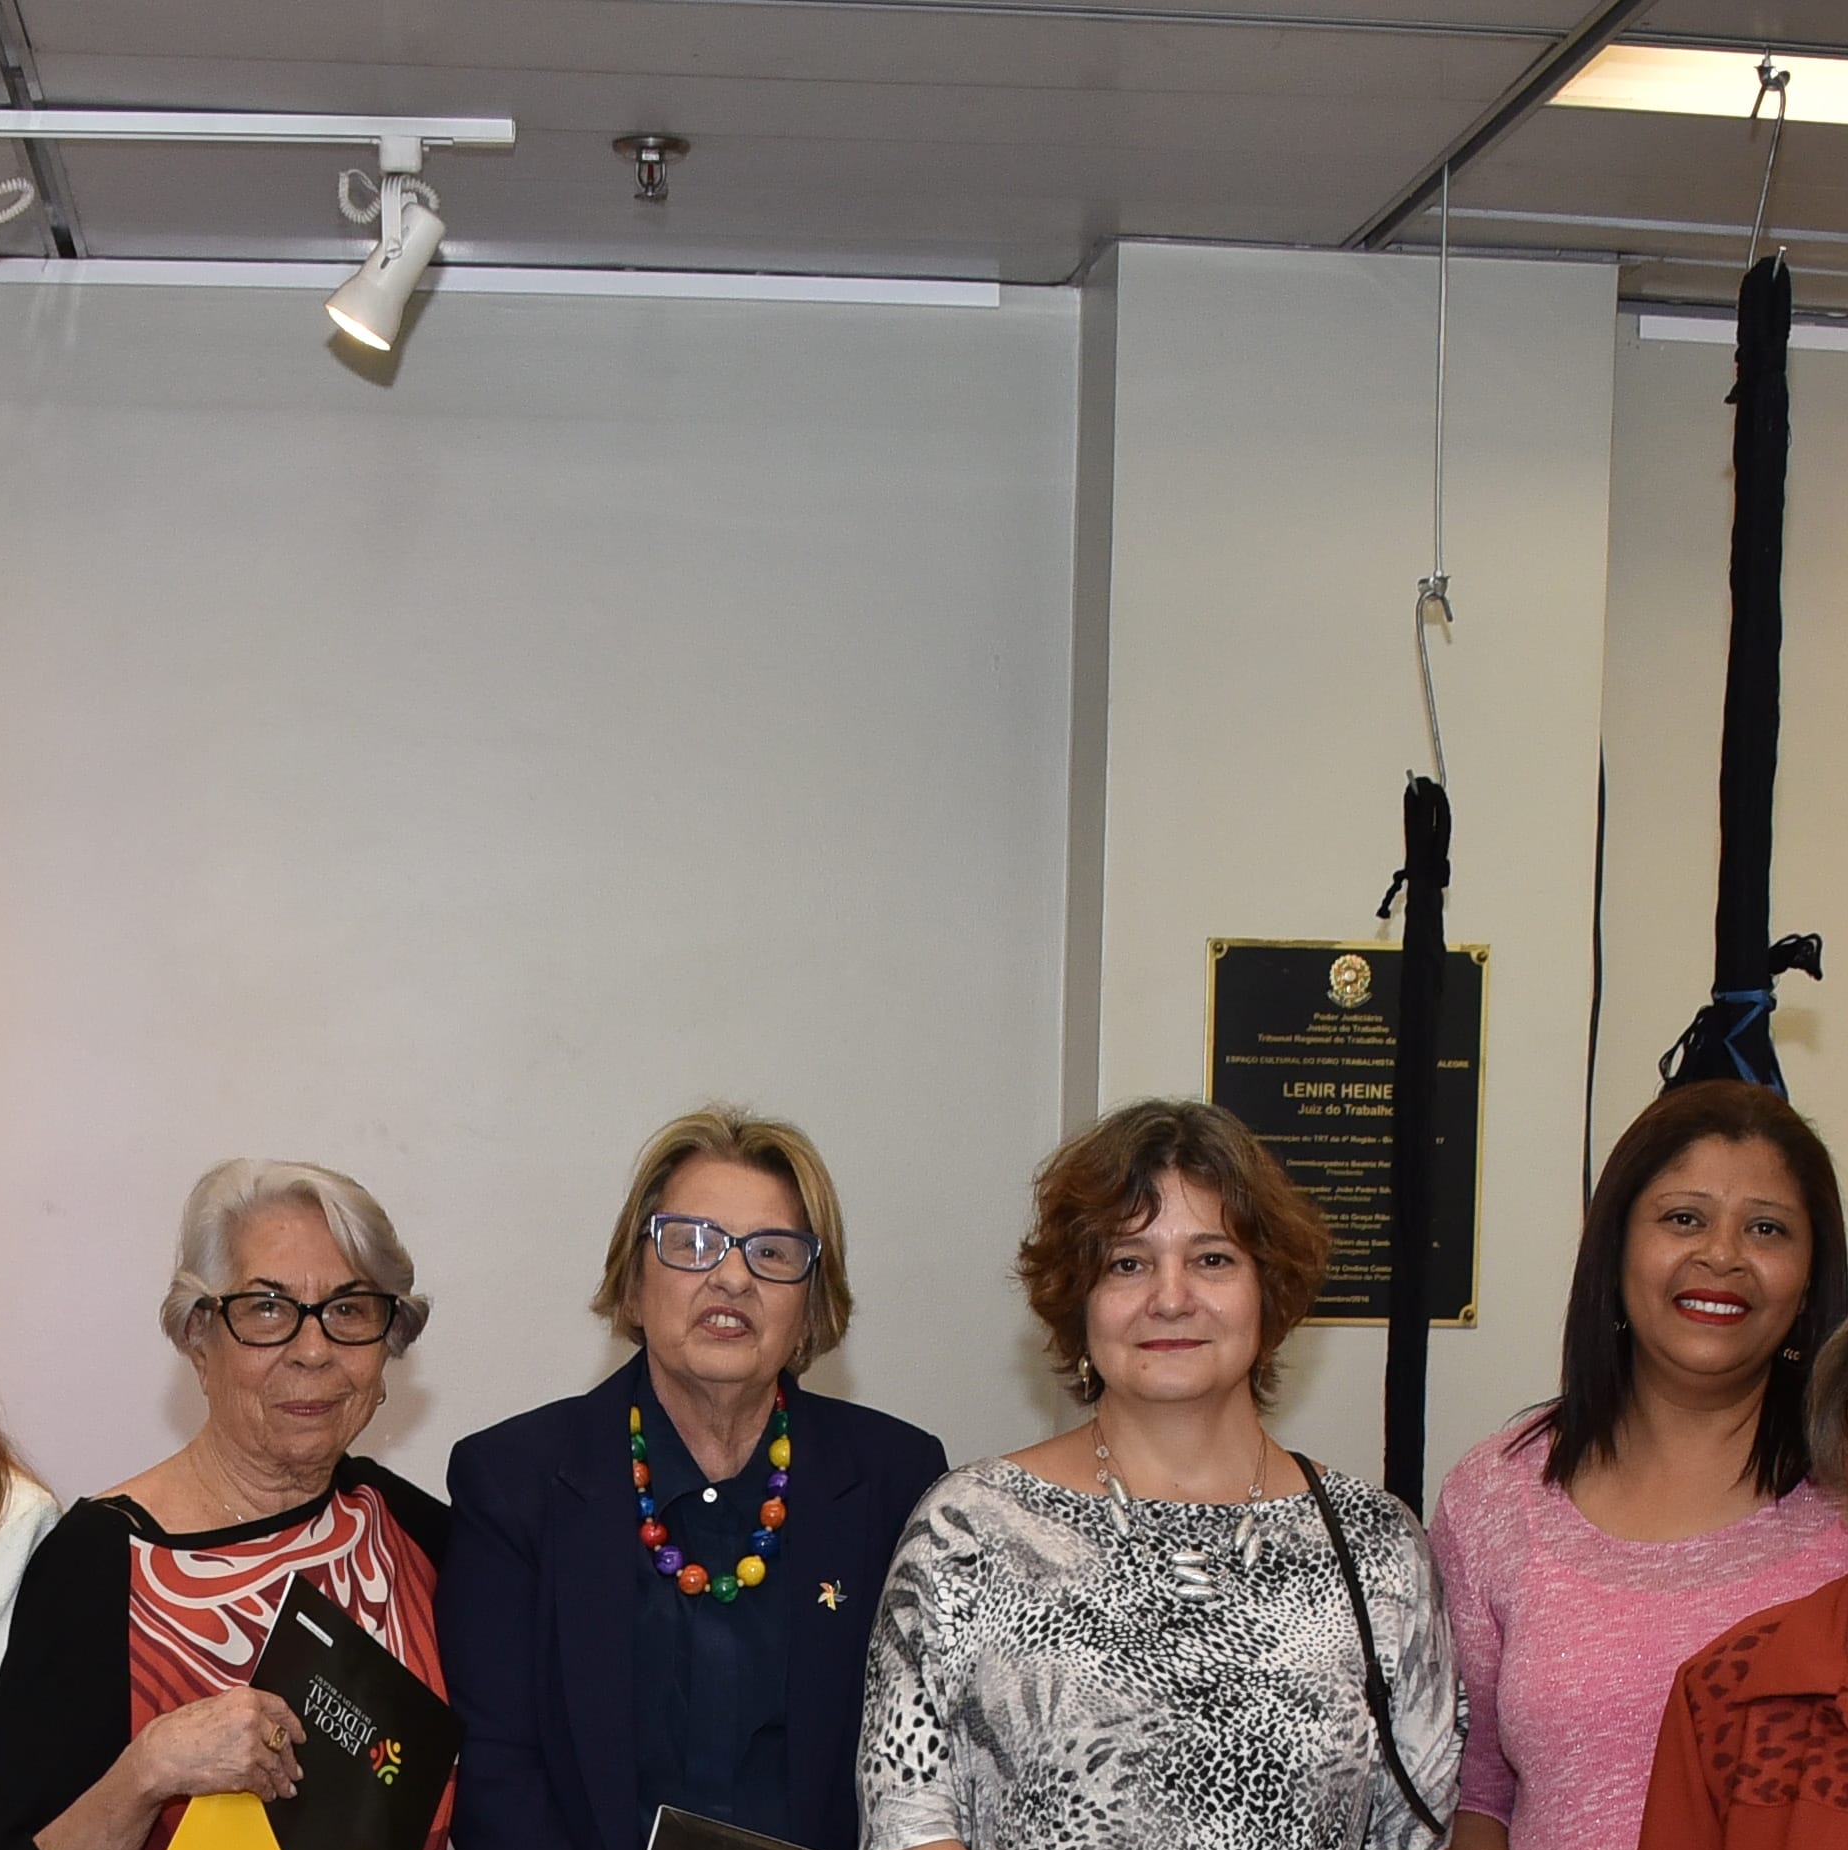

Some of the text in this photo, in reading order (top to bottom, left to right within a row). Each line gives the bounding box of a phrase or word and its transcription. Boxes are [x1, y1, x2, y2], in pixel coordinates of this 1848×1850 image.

[1283, 1082, 1394, 1100] LENIR HEINE
[1298, 1103, 1322, 1115] Juiz
[1325, 1104, 1341, 1116] do
[304, 1698, 361, 1756] ESCOLA
[308, 1680, 377, 1744] JUDICIAL
